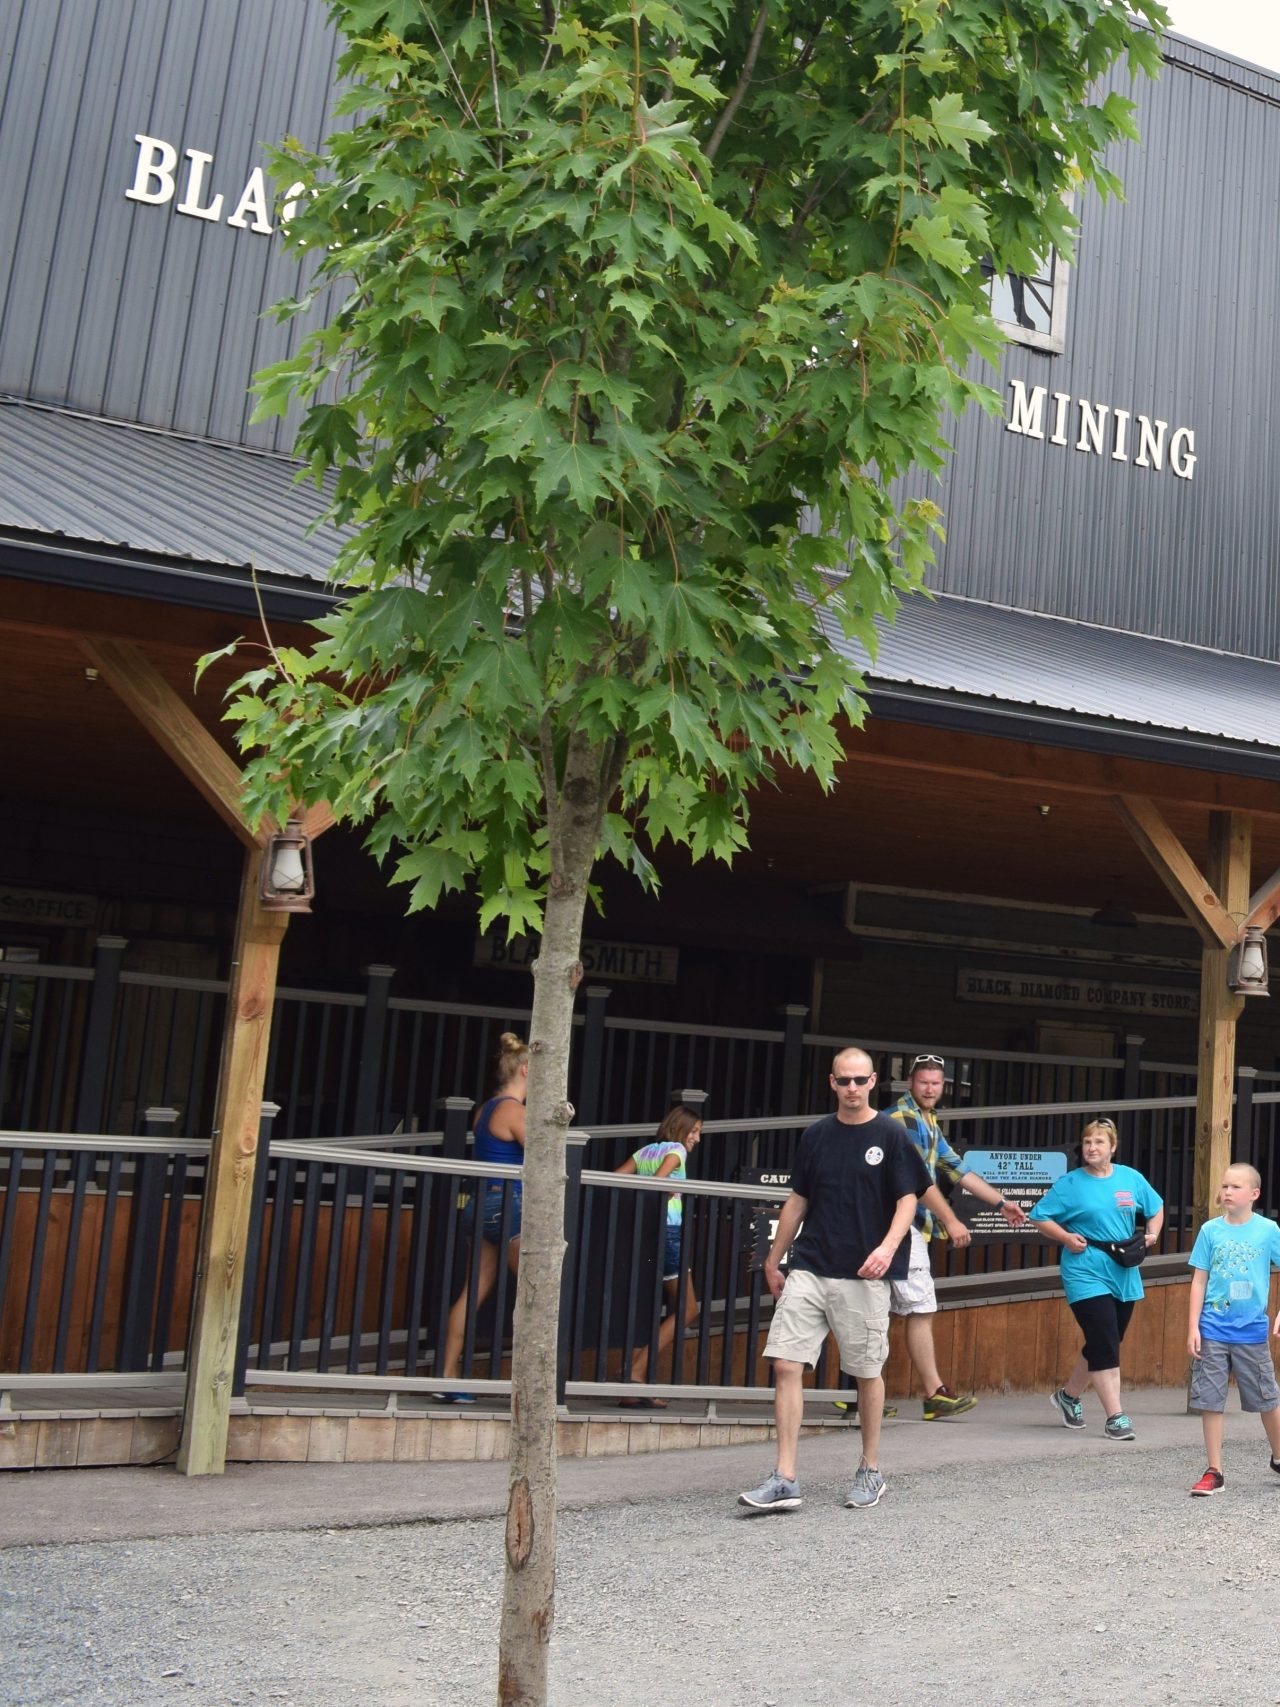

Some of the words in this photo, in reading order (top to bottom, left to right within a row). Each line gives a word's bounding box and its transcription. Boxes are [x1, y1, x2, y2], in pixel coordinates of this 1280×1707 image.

[125, 133, 320, 246] BLA
[1006, 378, 1198, 480] MINING
[21, 896, 86, 919] OFFICE
[491, 934, 663, 977] BLASMITH
[967, 976, 1012, 997] BLACK
[1020, 982, 1081, 1001] DIAMOND
[1087, 985, 1147, 1006] COMPANY
[1152, 992, 1191, 1009] STORE
[989, 1152, 1017, 1160] ANYONE
[1020, 1153, 1042, 1161] UNDER
[1015, 1162, 1034, 1170] TALL
[760, 1174, 791, 1184] CAU
